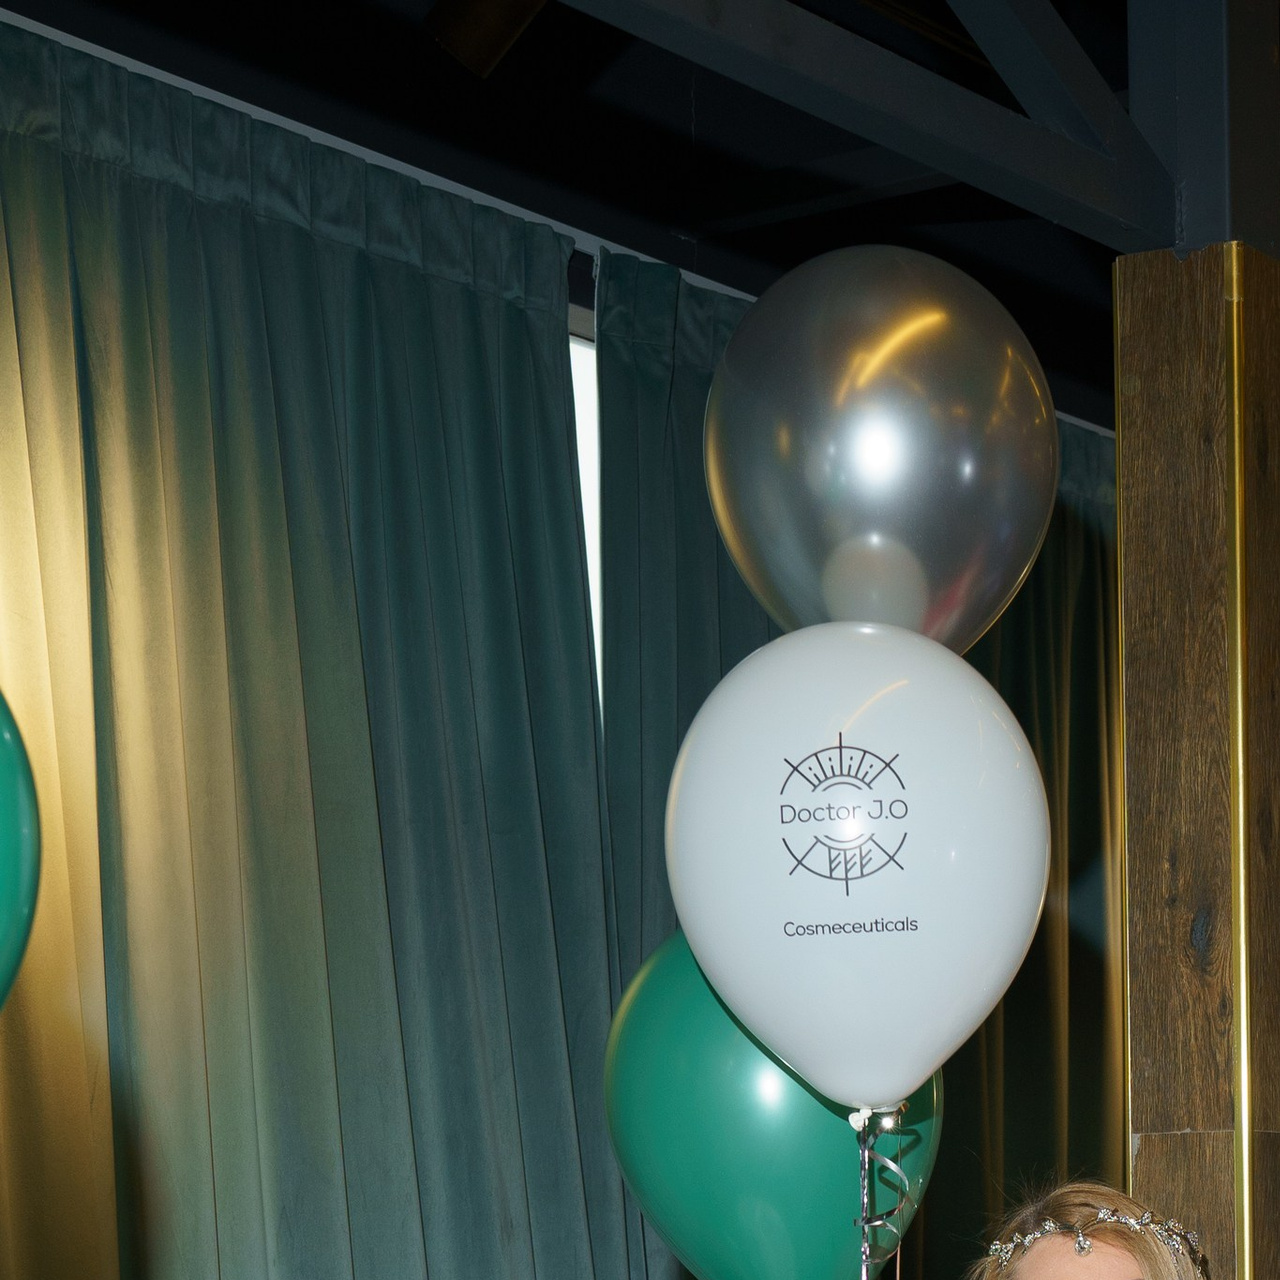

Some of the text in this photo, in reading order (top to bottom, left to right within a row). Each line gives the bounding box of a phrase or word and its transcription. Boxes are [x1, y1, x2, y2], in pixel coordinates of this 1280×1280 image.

[780, 799, 908, 824] Doctor J.O
[783, 916, 919, 937] Cosmeceuticals
